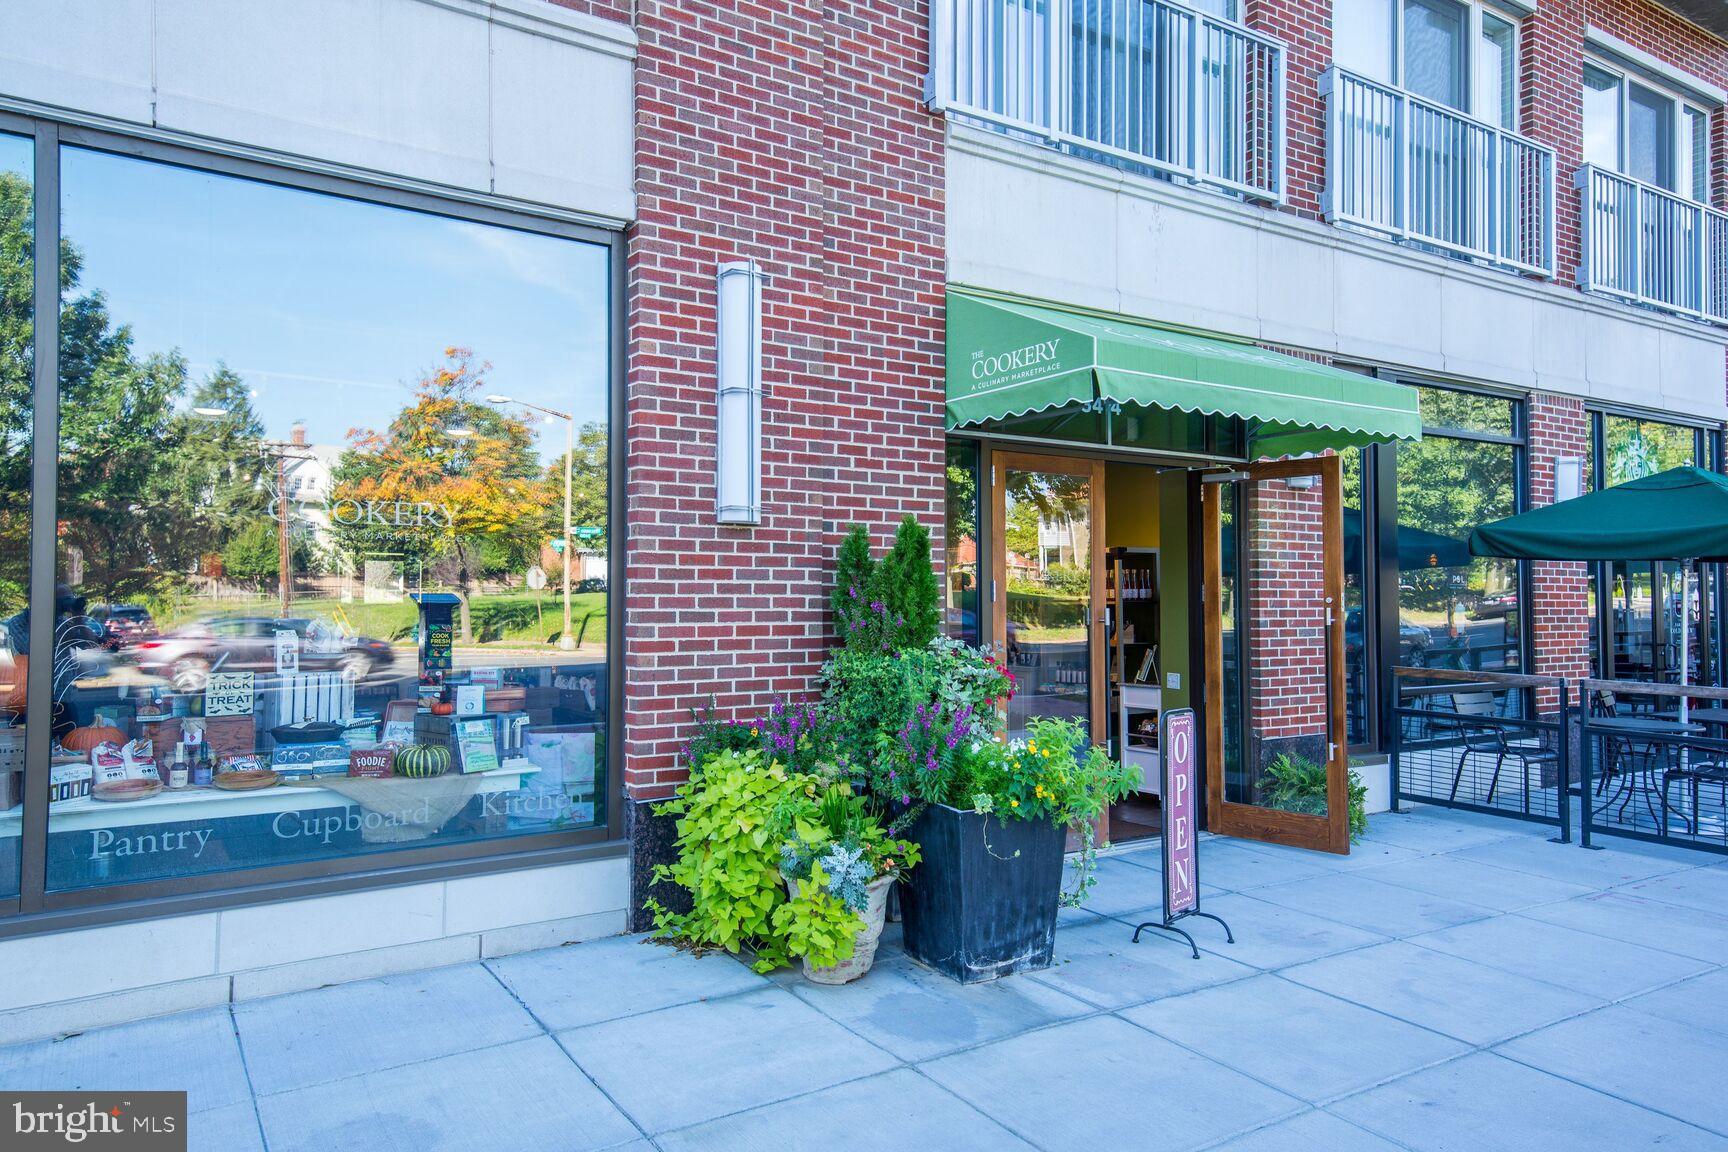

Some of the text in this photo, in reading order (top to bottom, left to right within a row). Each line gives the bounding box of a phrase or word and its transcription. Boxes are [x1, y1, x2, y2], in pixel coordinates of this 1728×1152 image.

[971, 350, 984, 360] THE
[972, 338, 1060, 379] COOKERY
[978, 375, 1009, 390] CULINARY
[1011, 362, 1061, 381] MARKETPLACE
[268, 496, 458, 527] COOKERY
[284, 527, 357, 540] CULARY
[208, 694, 252, 705] TREAT
[210, 681, 251, 690] TRICK
[356, 756, 387, 767] FOODIE
[479, 783, 583, 818] Kitchen
[1174, 731, 1190, 894] OPEN
[272, 797, 431, 844] Cupboard
[88, 828, 214, 860] Pantry
